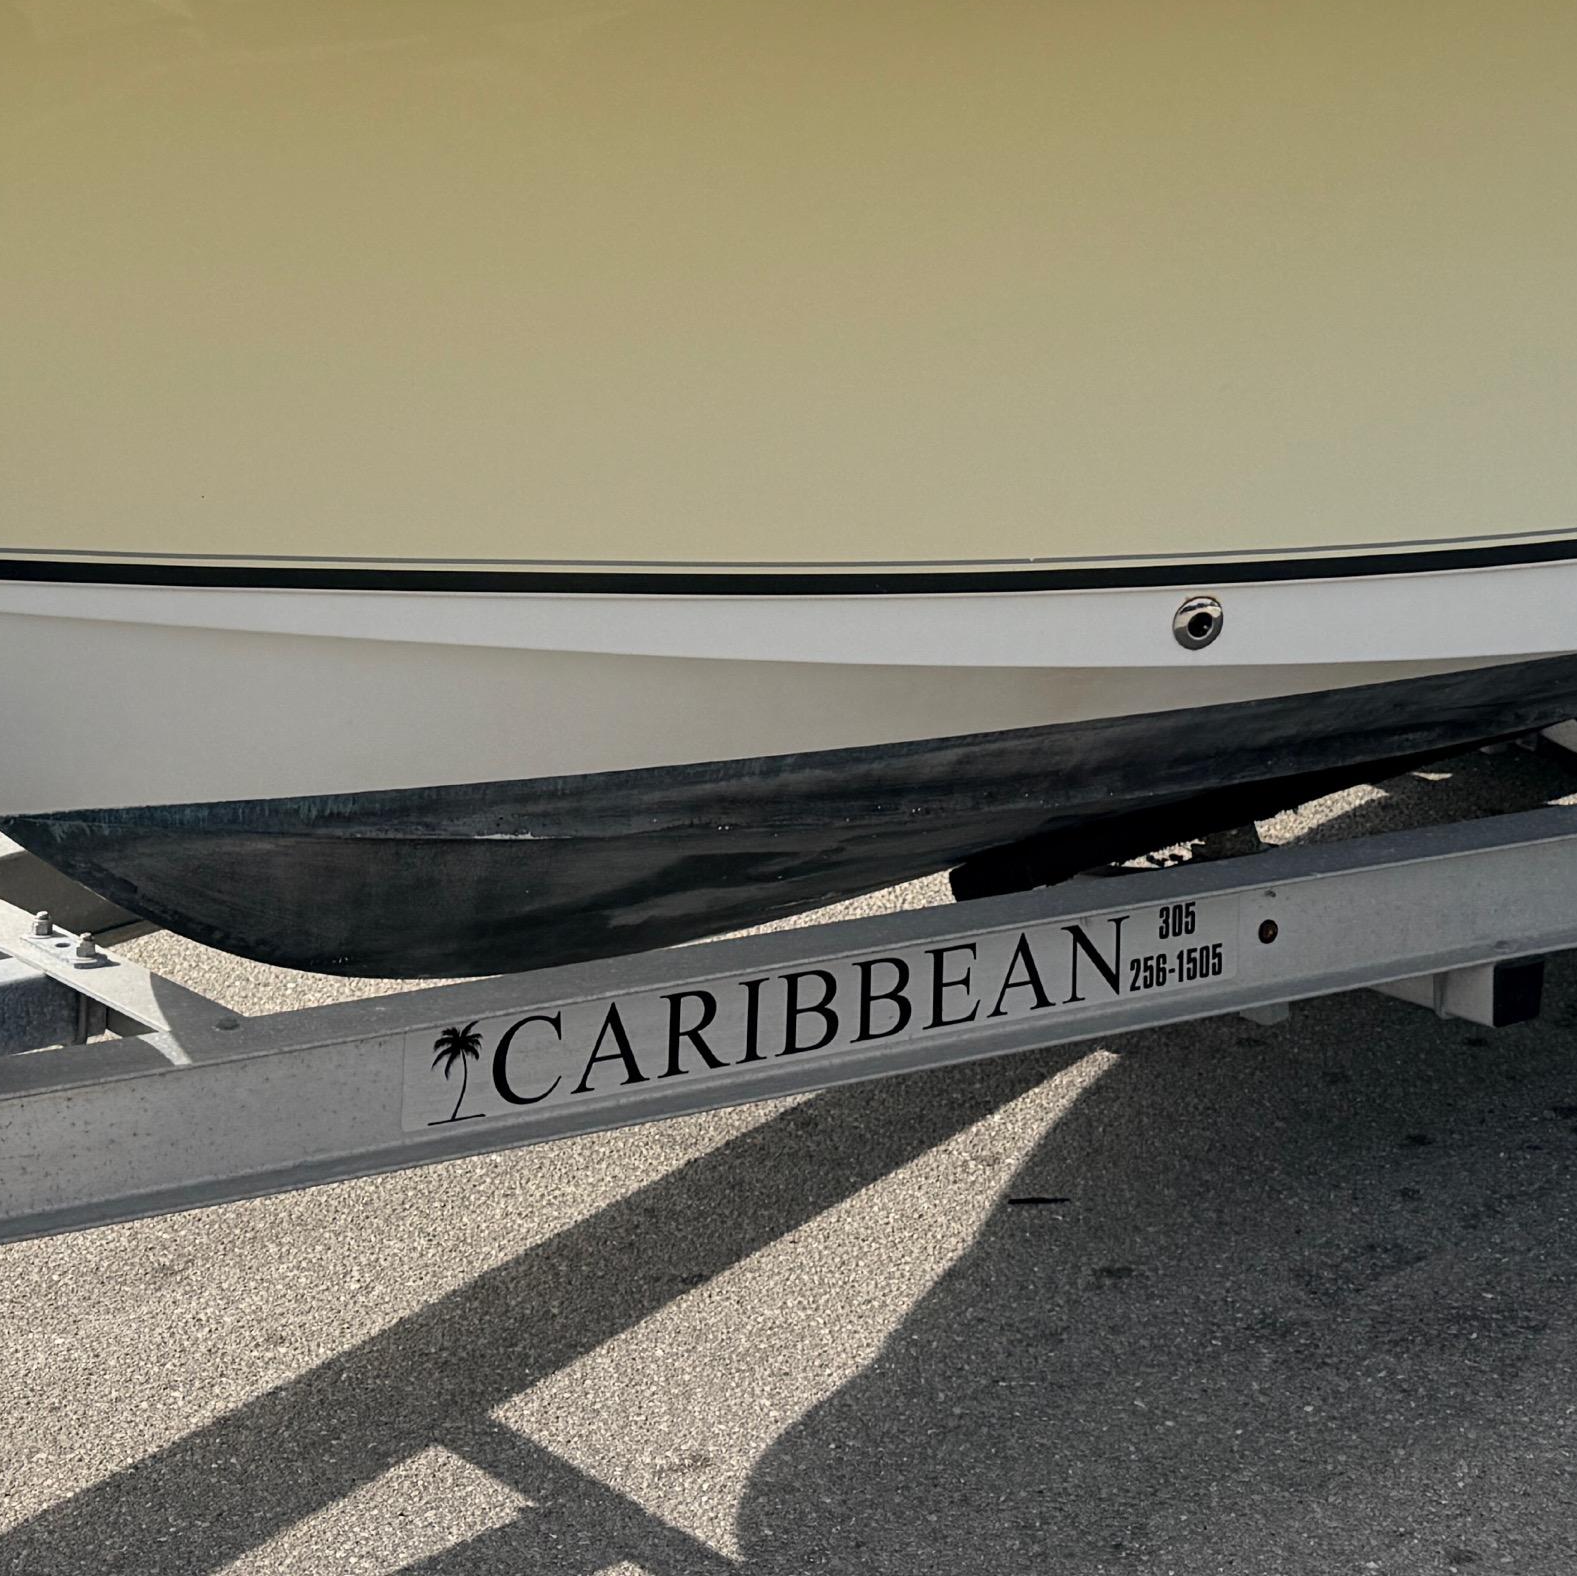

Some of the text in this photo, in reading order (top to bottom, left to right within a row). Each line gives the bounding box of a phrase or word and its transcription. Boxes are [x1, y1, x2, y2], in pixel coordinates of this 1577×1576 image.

[1158, 901, 1196, 939] 305
[1129, 942, 1223, 992] 256-1505
[491, 915, 1130, 1106] CARIBBEAN
